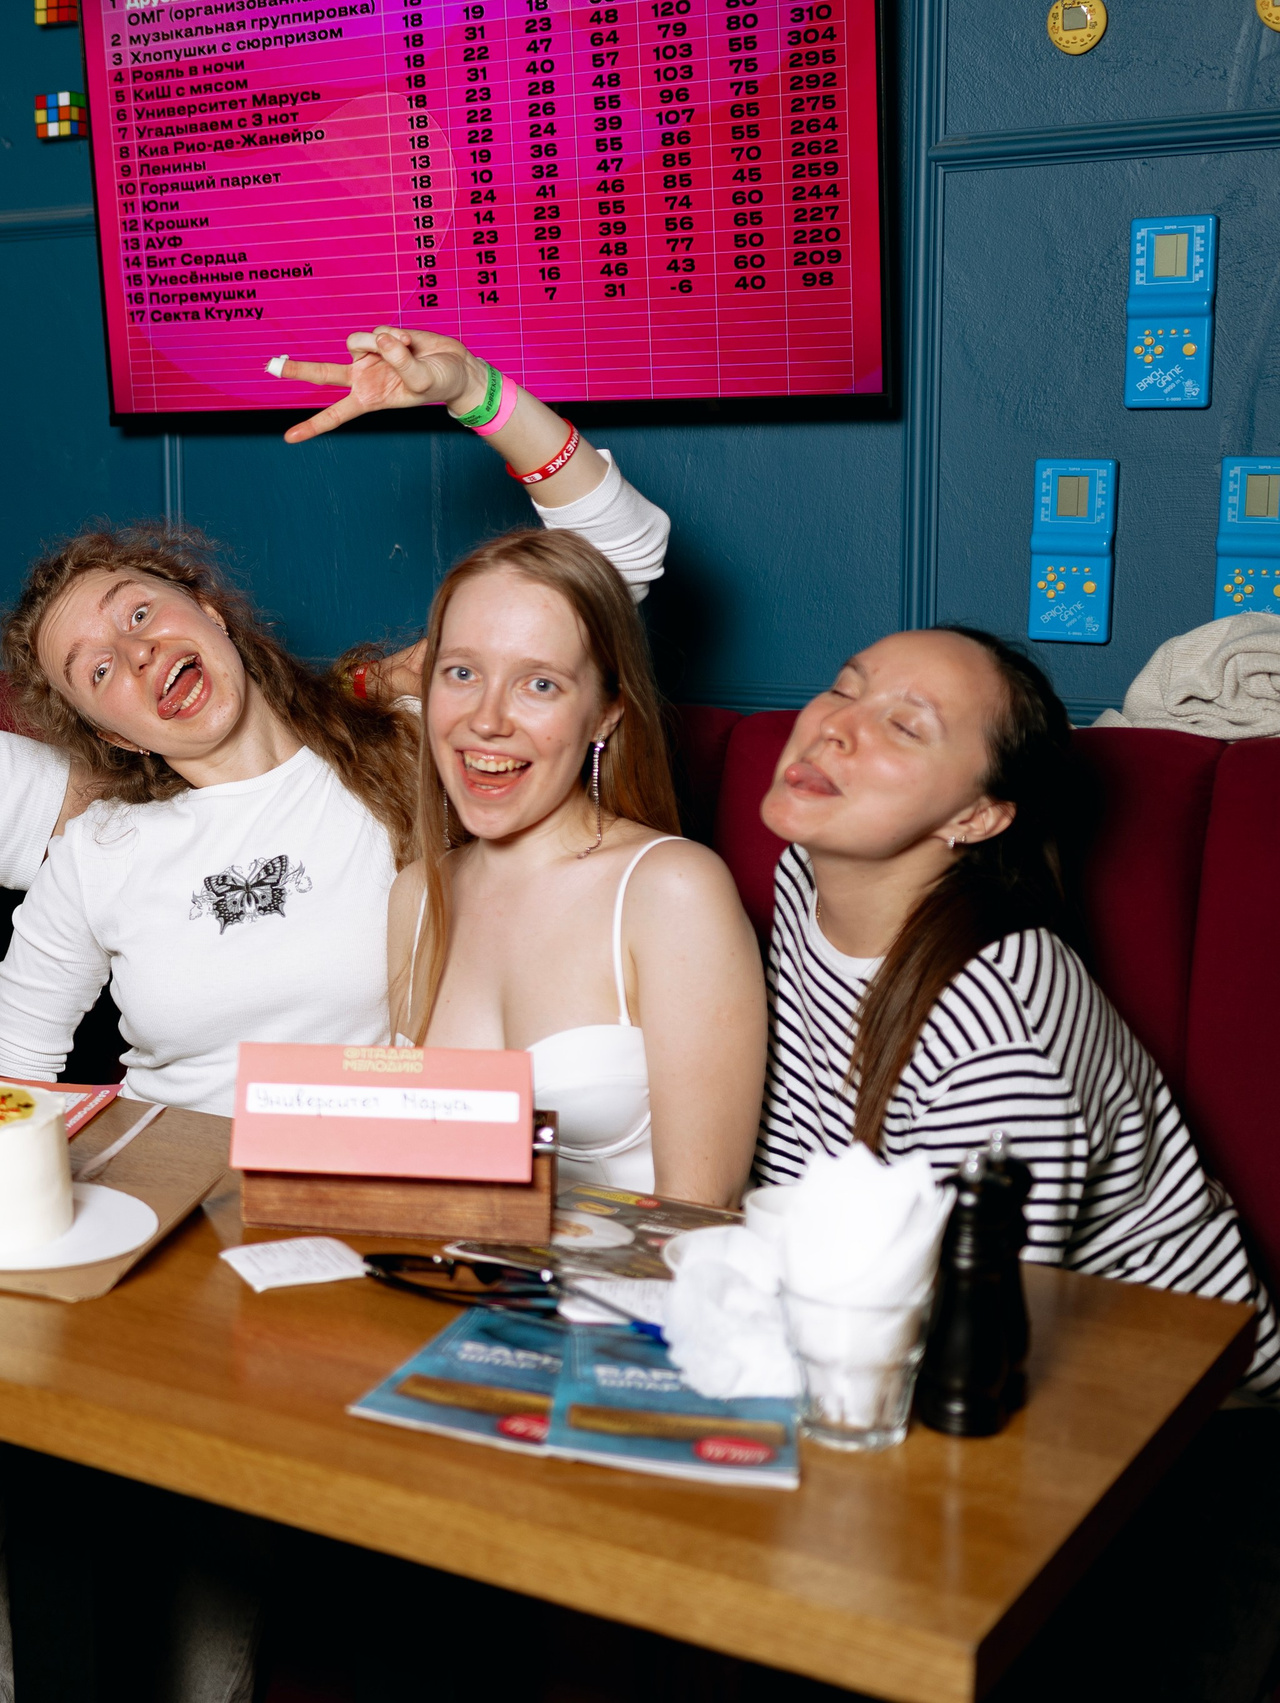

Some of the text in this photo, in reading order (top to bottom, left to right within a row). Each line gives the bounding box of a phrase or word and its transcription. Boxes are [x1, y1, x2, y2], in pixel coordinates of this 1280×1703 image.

[111, 0, 375, 47] 2 музыкальная группировка)
[112, 0, 548, 66] 3 Хлопушки с сюрпризом 19 18
[114, 0, 691, 84] 4 Рояль в ночи 31 23 48 120
[115, 4, 832, 103] 5 КиШ с мясом 22 47 64 79 80 310
[128, 10, 164, 26] ОМГ
[116, 26, 837, 122] 6 Университет Марусь 31 40 57 103 55 304
[118, 48, 836, 140] 7 Угадываем с 3 нот 23 28 48 103 75 295
[119, 72, 837, 159] 8 Киа Рио-де-Жанейро 22 26 55 96 75 292
[120, 94, 836, 177] 9 Ленины 22 24 39 107 65 275
[118, 116, 839, 196] 10 Горящий паркет 19 36 55 86 55 264
[123, 138, 839, 214] 11 Юпи 10 32 47 85 70 262
[122, 160, 839, 233] 12 Крошки 24 41 46 85 45 259
[123, 183, 840, 250] 13 АУФ 14 23 55 74 60 244
[124, 205, 839, 268] 14 Бит Сердца 23 29 39 56 65 227
[126, 227, 841, 287] 15 Унесённые песней 15 12 48 77 50 220
[127, 249, 842, 306] 16 Погремушки 31 16 46 43 60 209
[129, 271, 834, 323] 17 Секта Ктулху 14 7 31 -6 40 98
